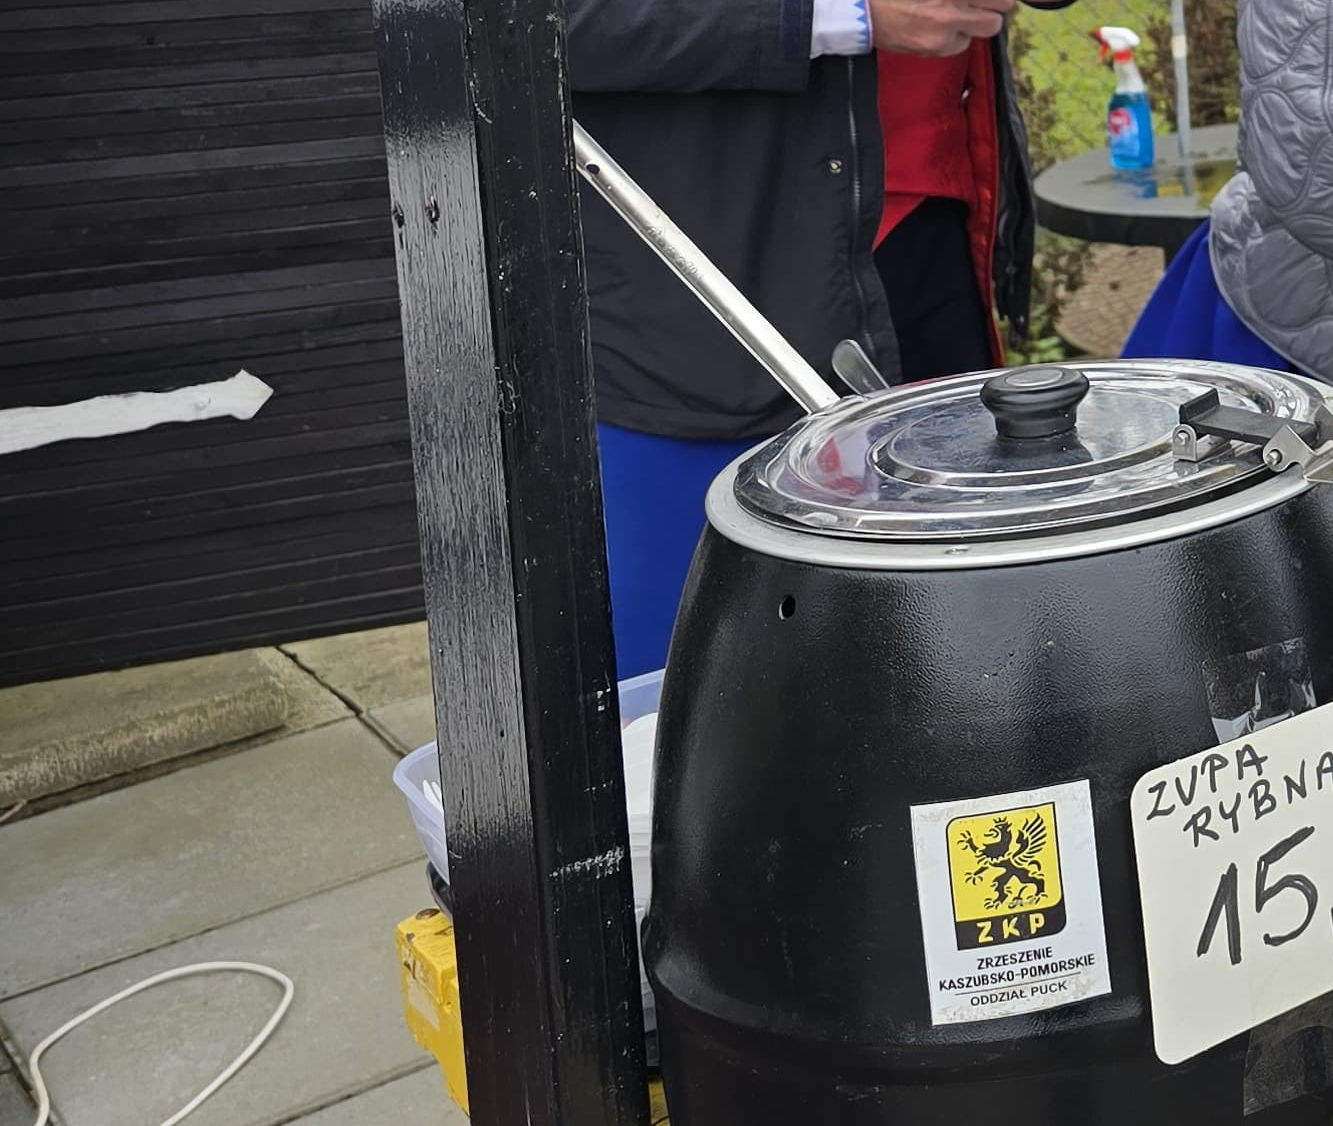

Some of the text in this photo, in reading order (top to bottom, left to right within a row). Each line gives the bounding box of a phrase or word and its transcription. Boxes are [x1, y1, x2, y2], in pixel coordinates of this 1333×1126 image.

[1147, 744, 1268, 820] ZUPA
[976, 913, 1046, 944] ZKP
[939, 953, 1096, 991] KASZUBSKO-POMORSKIE
[977, 946, 1053, 970] ZRZESZENIE
[970, 980, 1068, 1007] ODDZIAŁ PUCK
